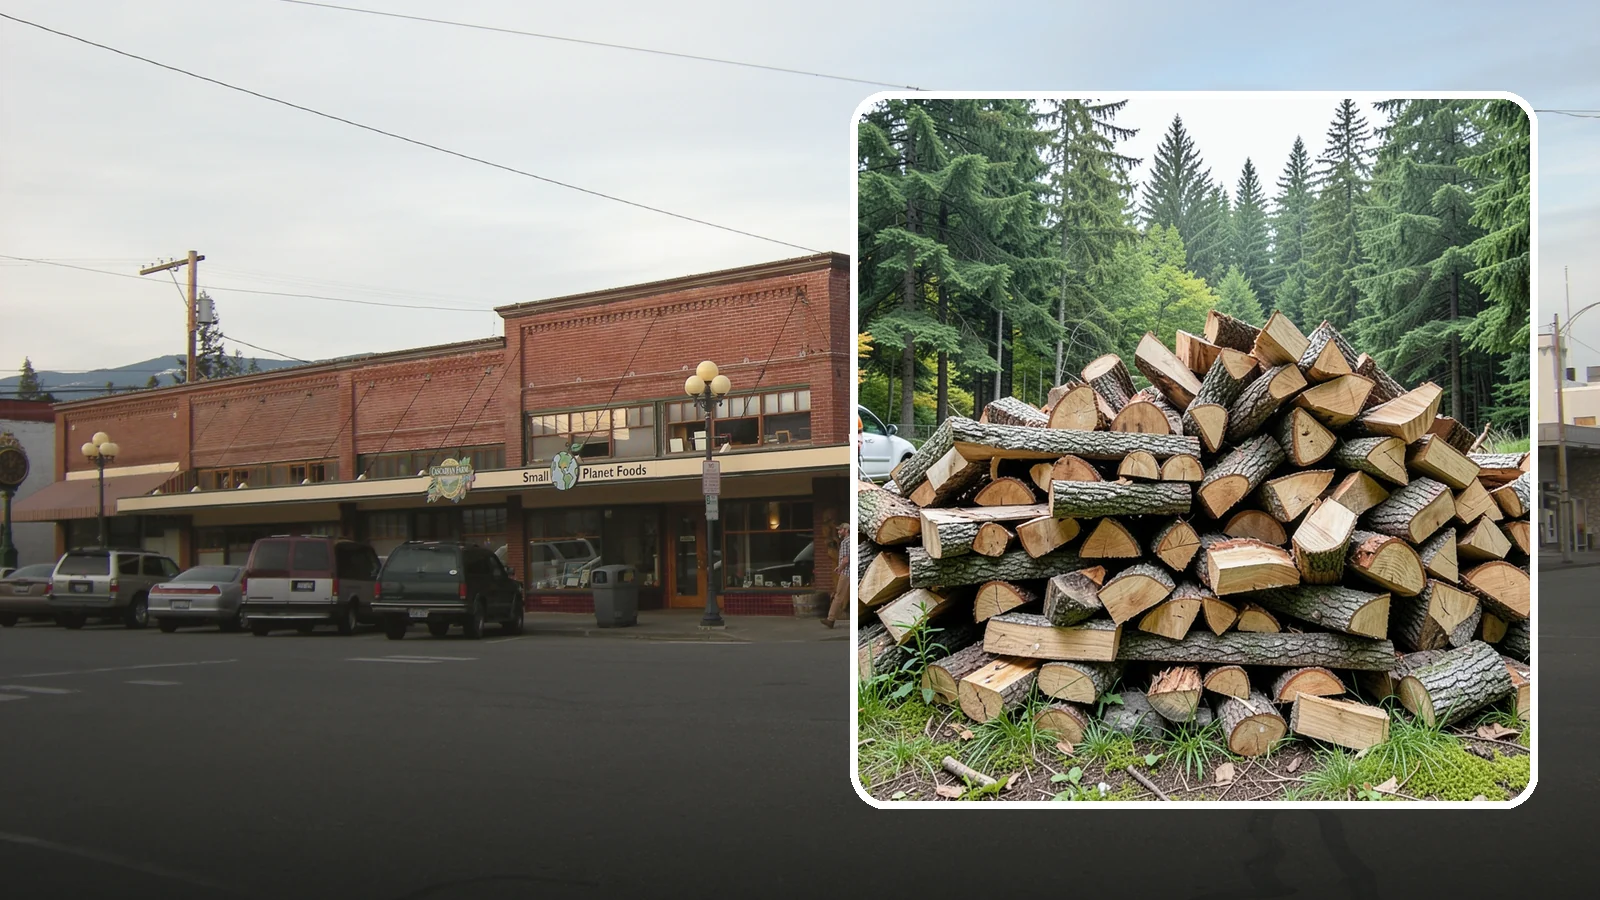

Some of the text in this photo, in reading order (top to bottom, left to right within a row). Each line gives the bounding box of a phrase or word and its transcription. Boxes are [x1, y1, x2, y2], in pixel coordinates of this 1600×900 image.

[523, 464, 647, 482] Small Planet Foods
